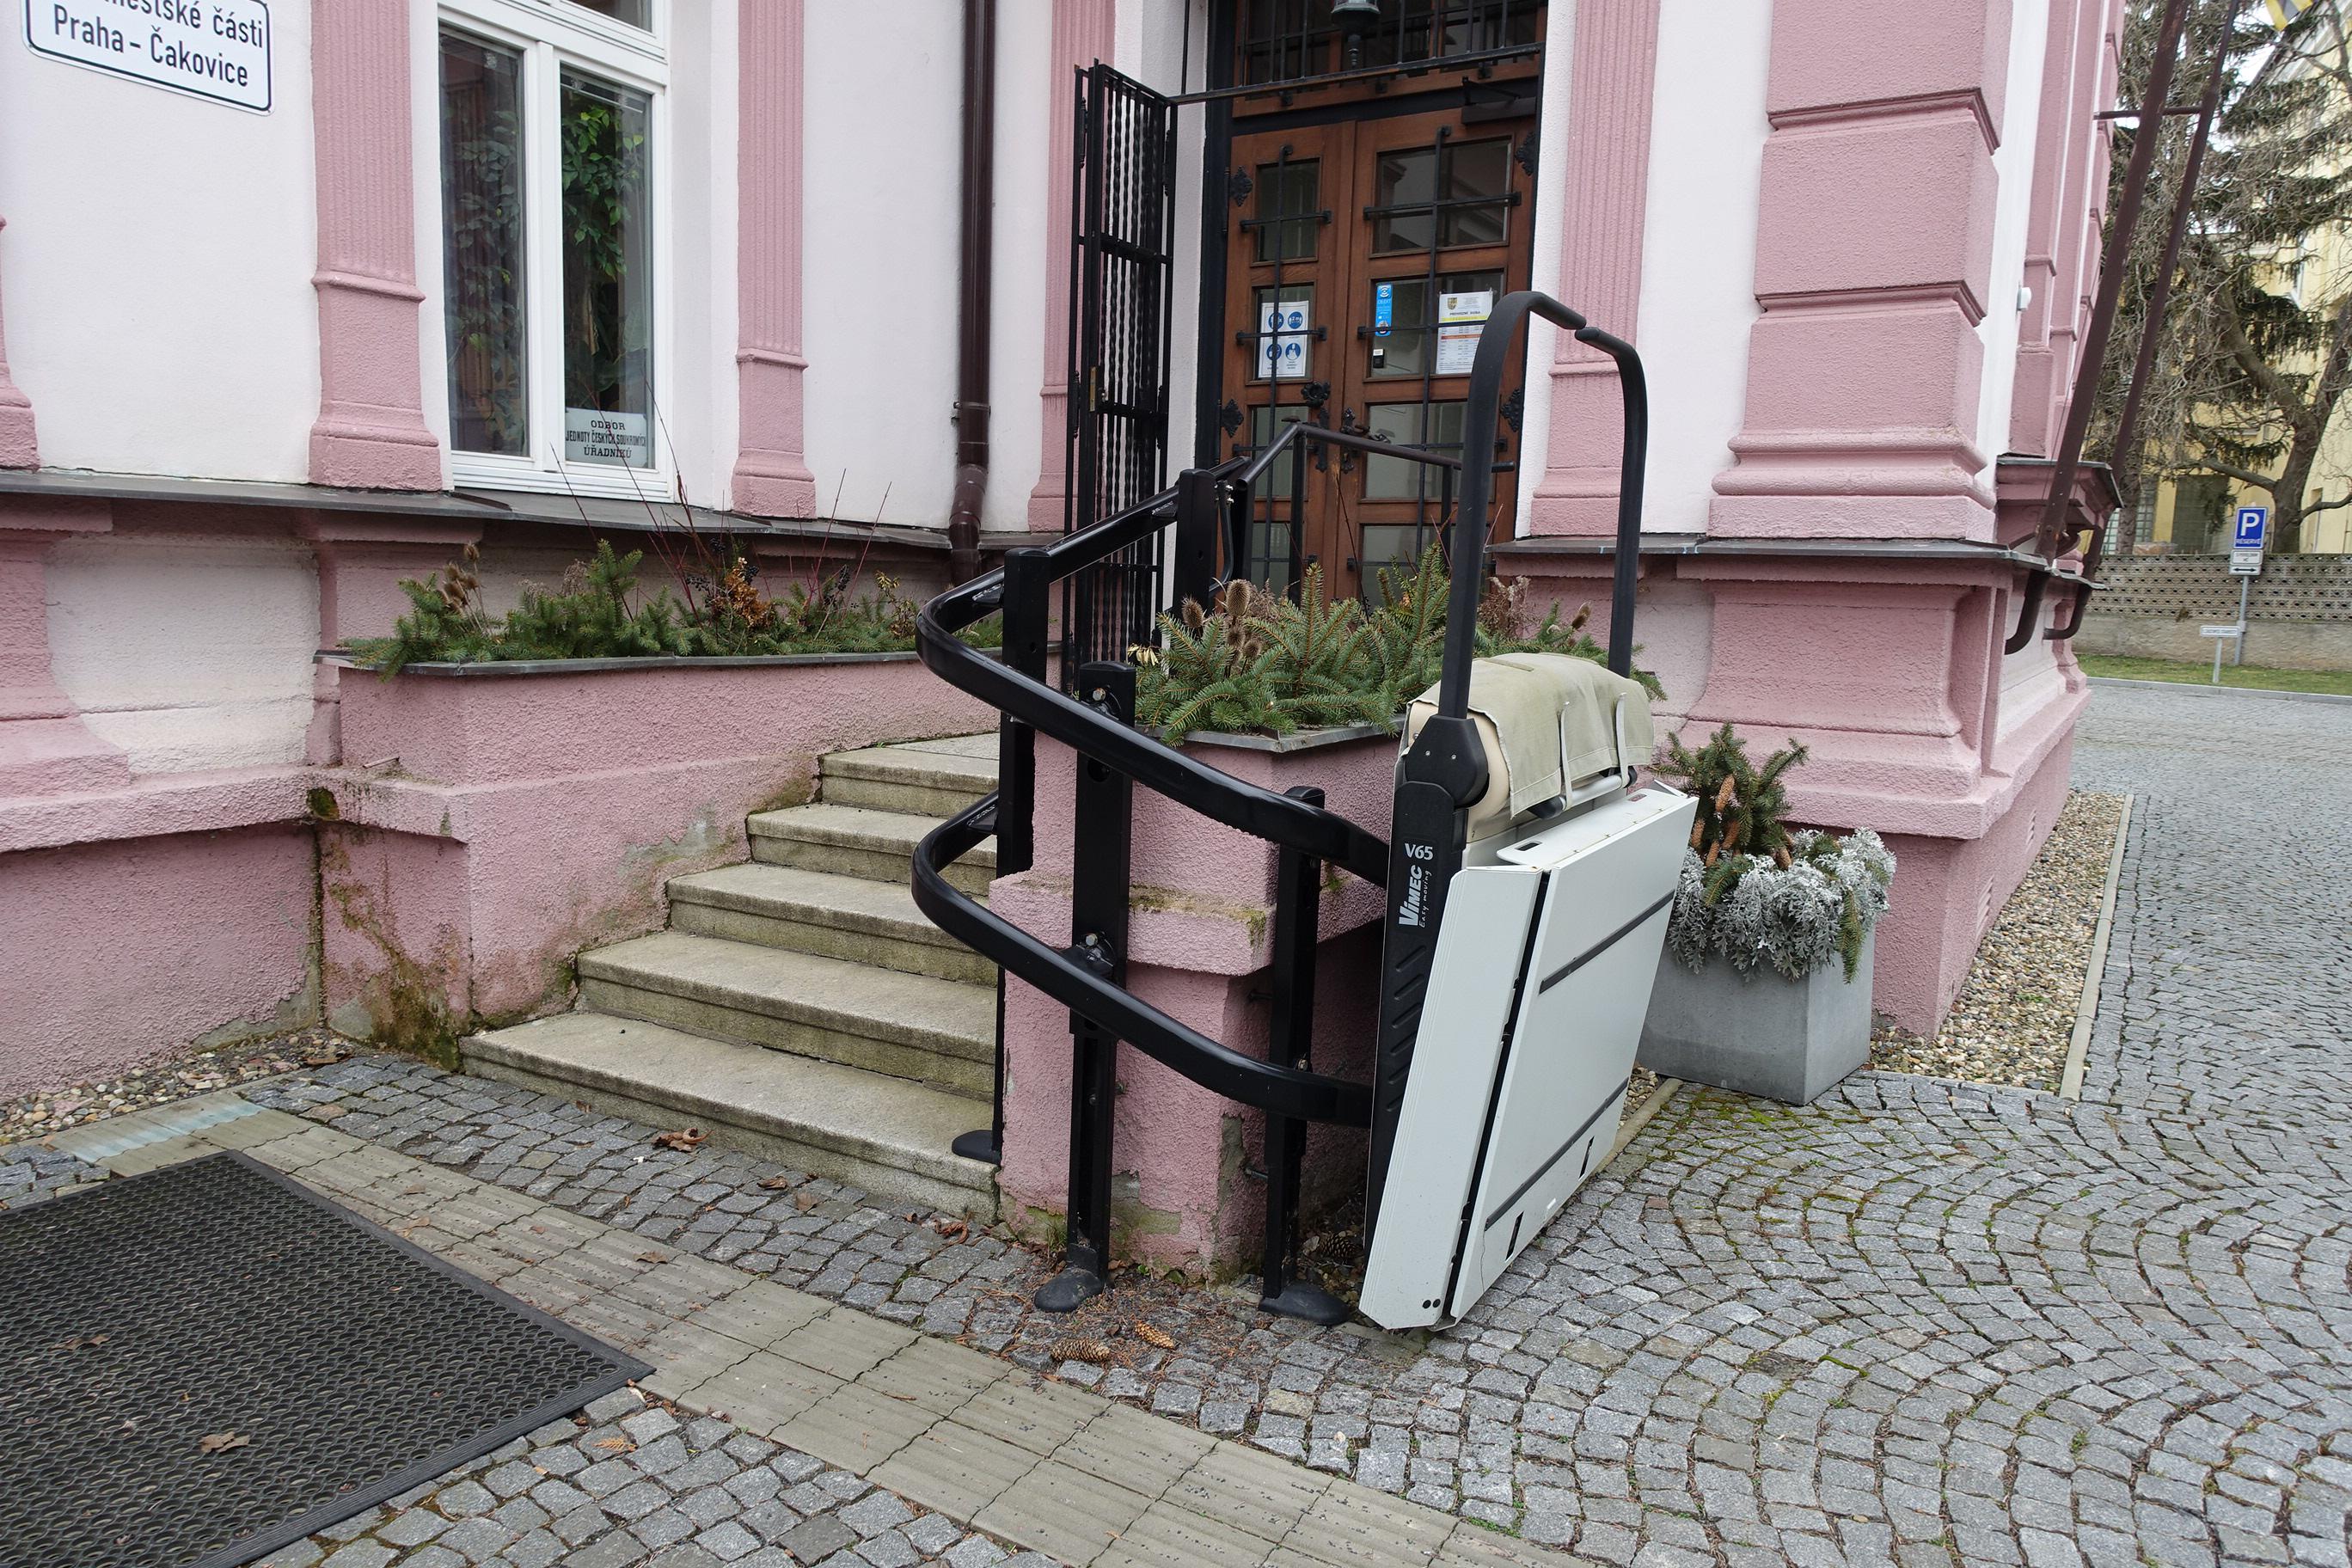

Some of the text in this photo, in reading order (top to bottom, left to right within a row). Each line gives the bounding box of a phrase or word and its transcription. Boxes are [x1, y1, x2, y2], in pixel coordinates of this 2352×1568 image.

[105, 0, 263, 49] stské části
[591, 420, 626, 431] ODBOR
[565, 430, 590, 443] JEDNOTY
[2240, 512, 2260, 536] P
[1404, 842, 1434, 861] V65
[1418, 870, 1432, 928] Easy moving
